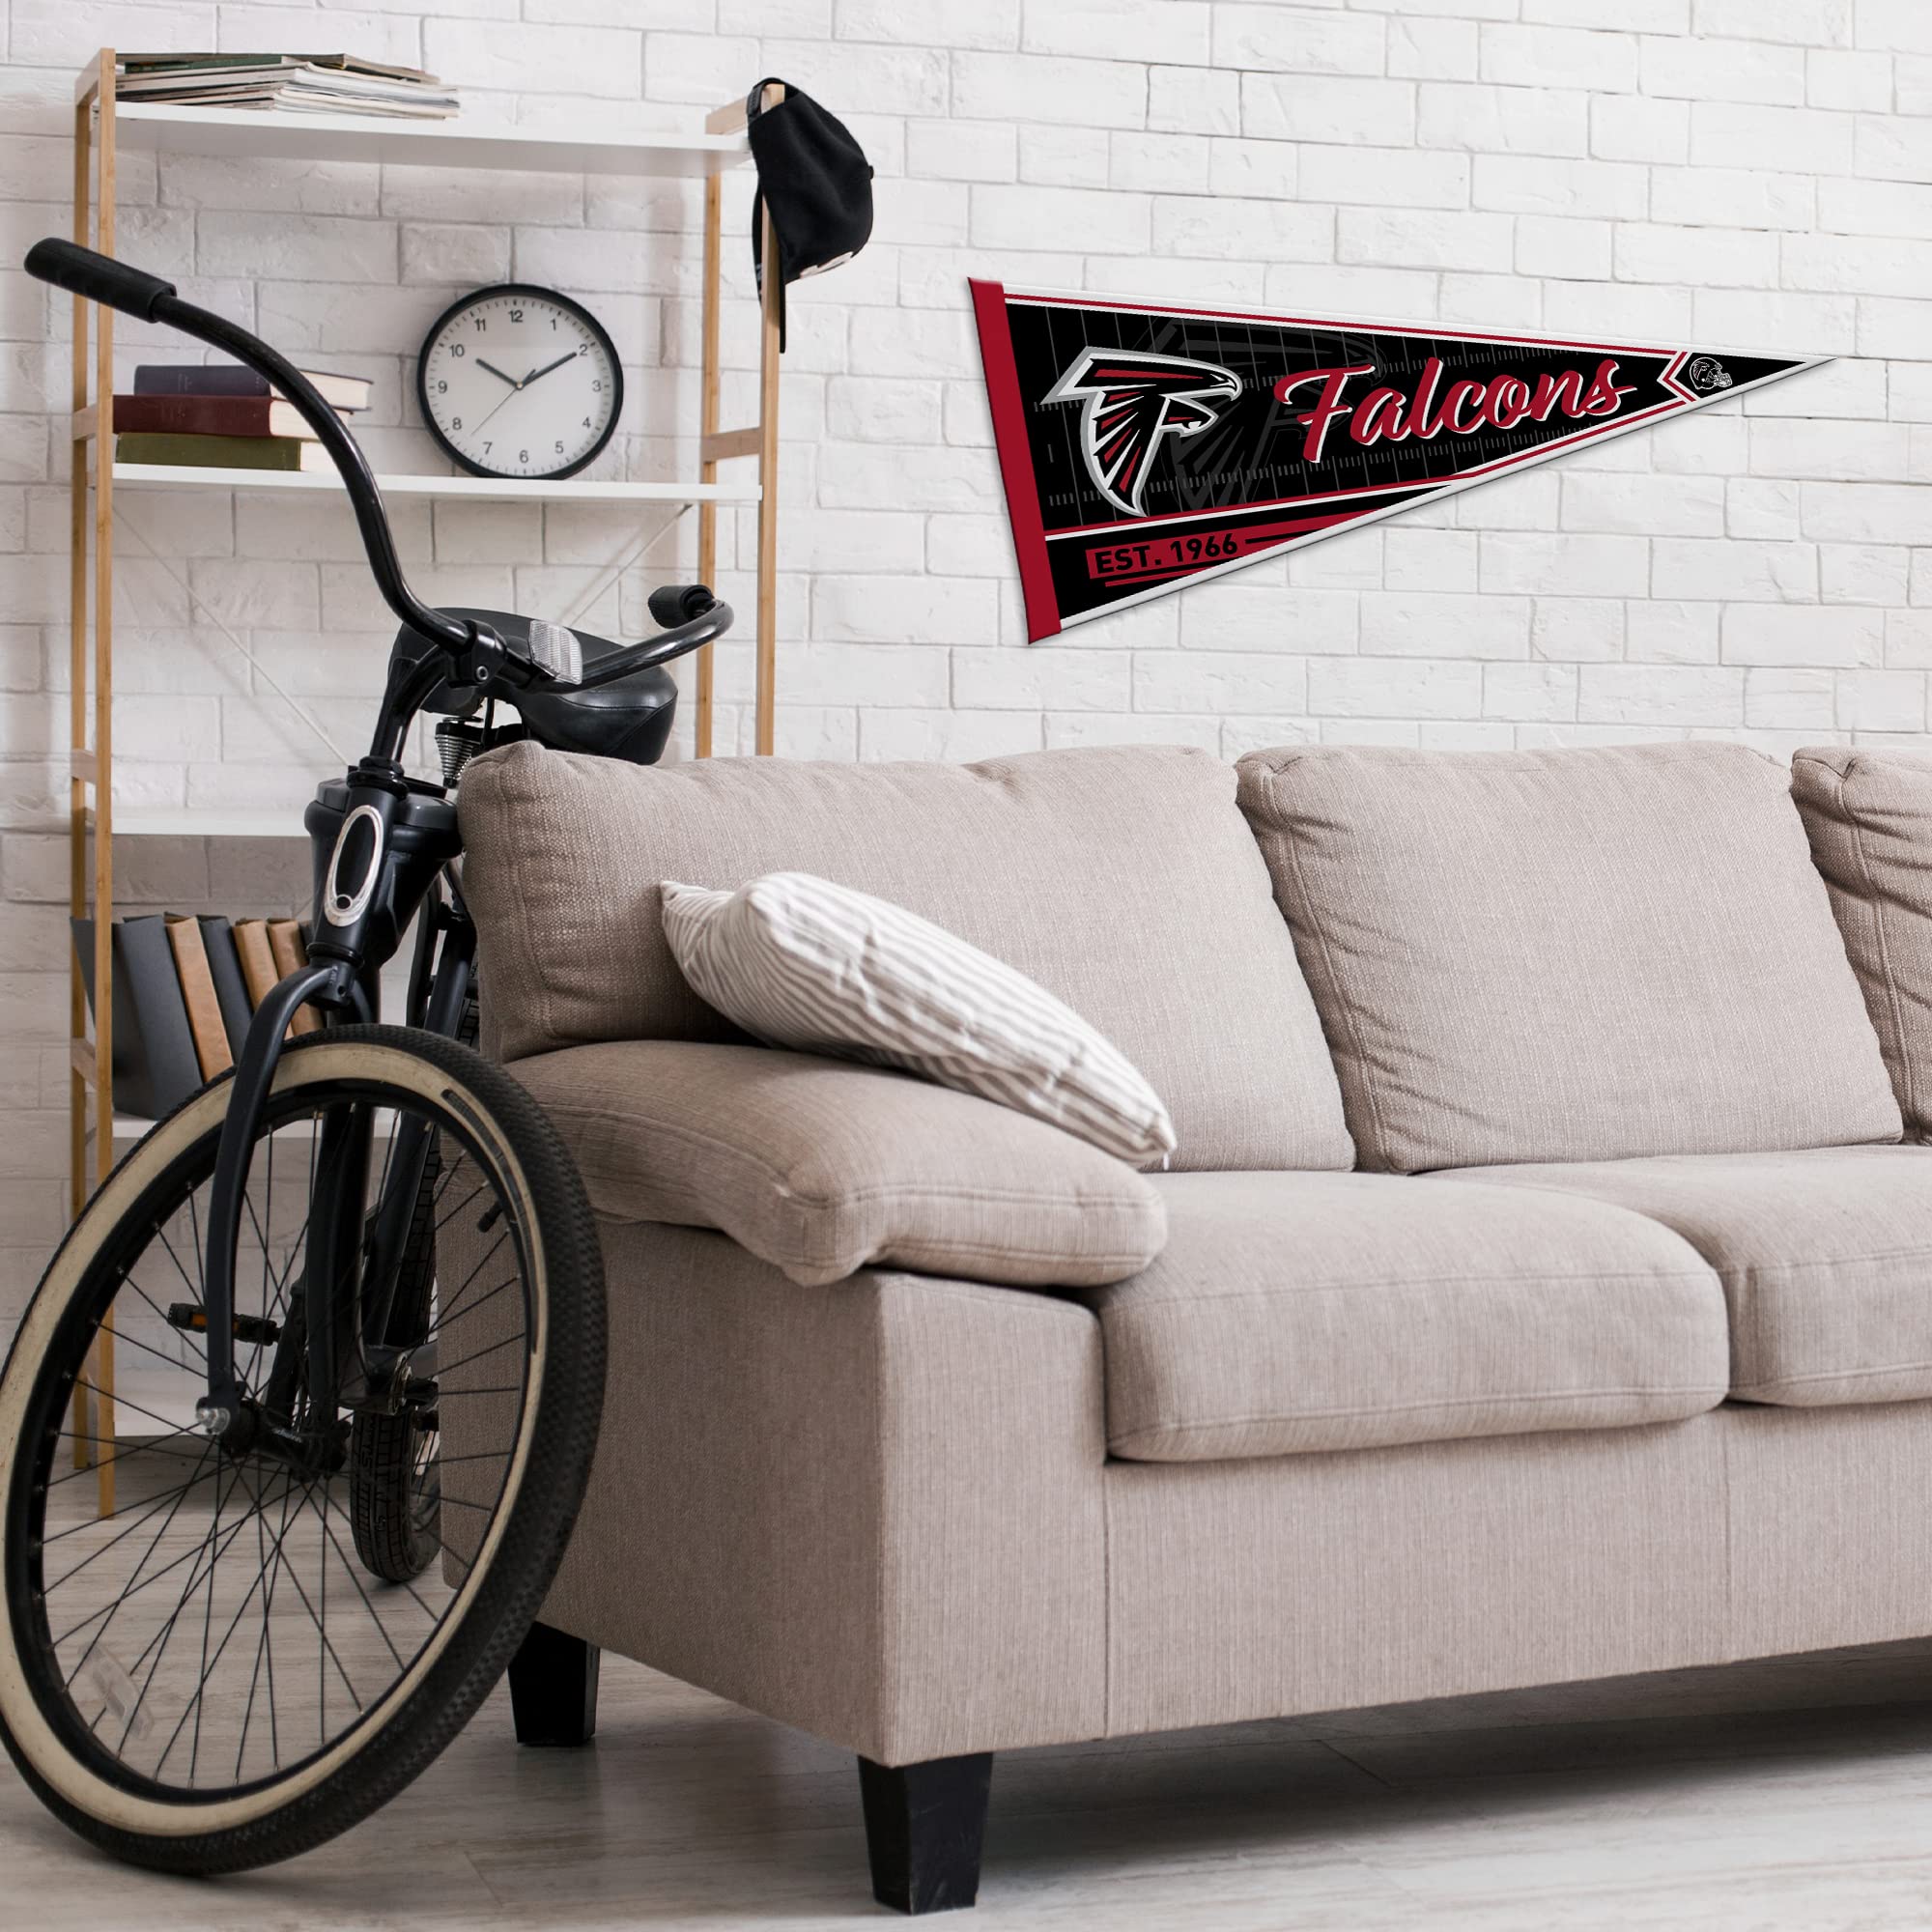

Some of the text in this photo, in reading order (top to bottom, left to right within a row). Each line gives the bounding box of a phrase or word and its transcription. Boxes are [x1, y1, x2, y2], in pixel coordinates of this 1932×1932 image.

[508, 309, 524, 324] 12
[474, 319, 487, 332] 11
[550, 319, 556, 330] 1
[449, 344, 465, 357] 10
[579, 344, 588, 356] 2
[438, 381, 448, 394] 9
[591, 380, 602, 392] 3
[1274, 357, 1638, 464] Falcons
[452, 416, 462, 431] 8
[582, 416, 591, 429] 4
[483, 440, 493, 455] 7
[554, 440, 564, 454] 5
[519, 449, 528, 464] 6
[1094, 533, 1238, 575] EST. 1966
